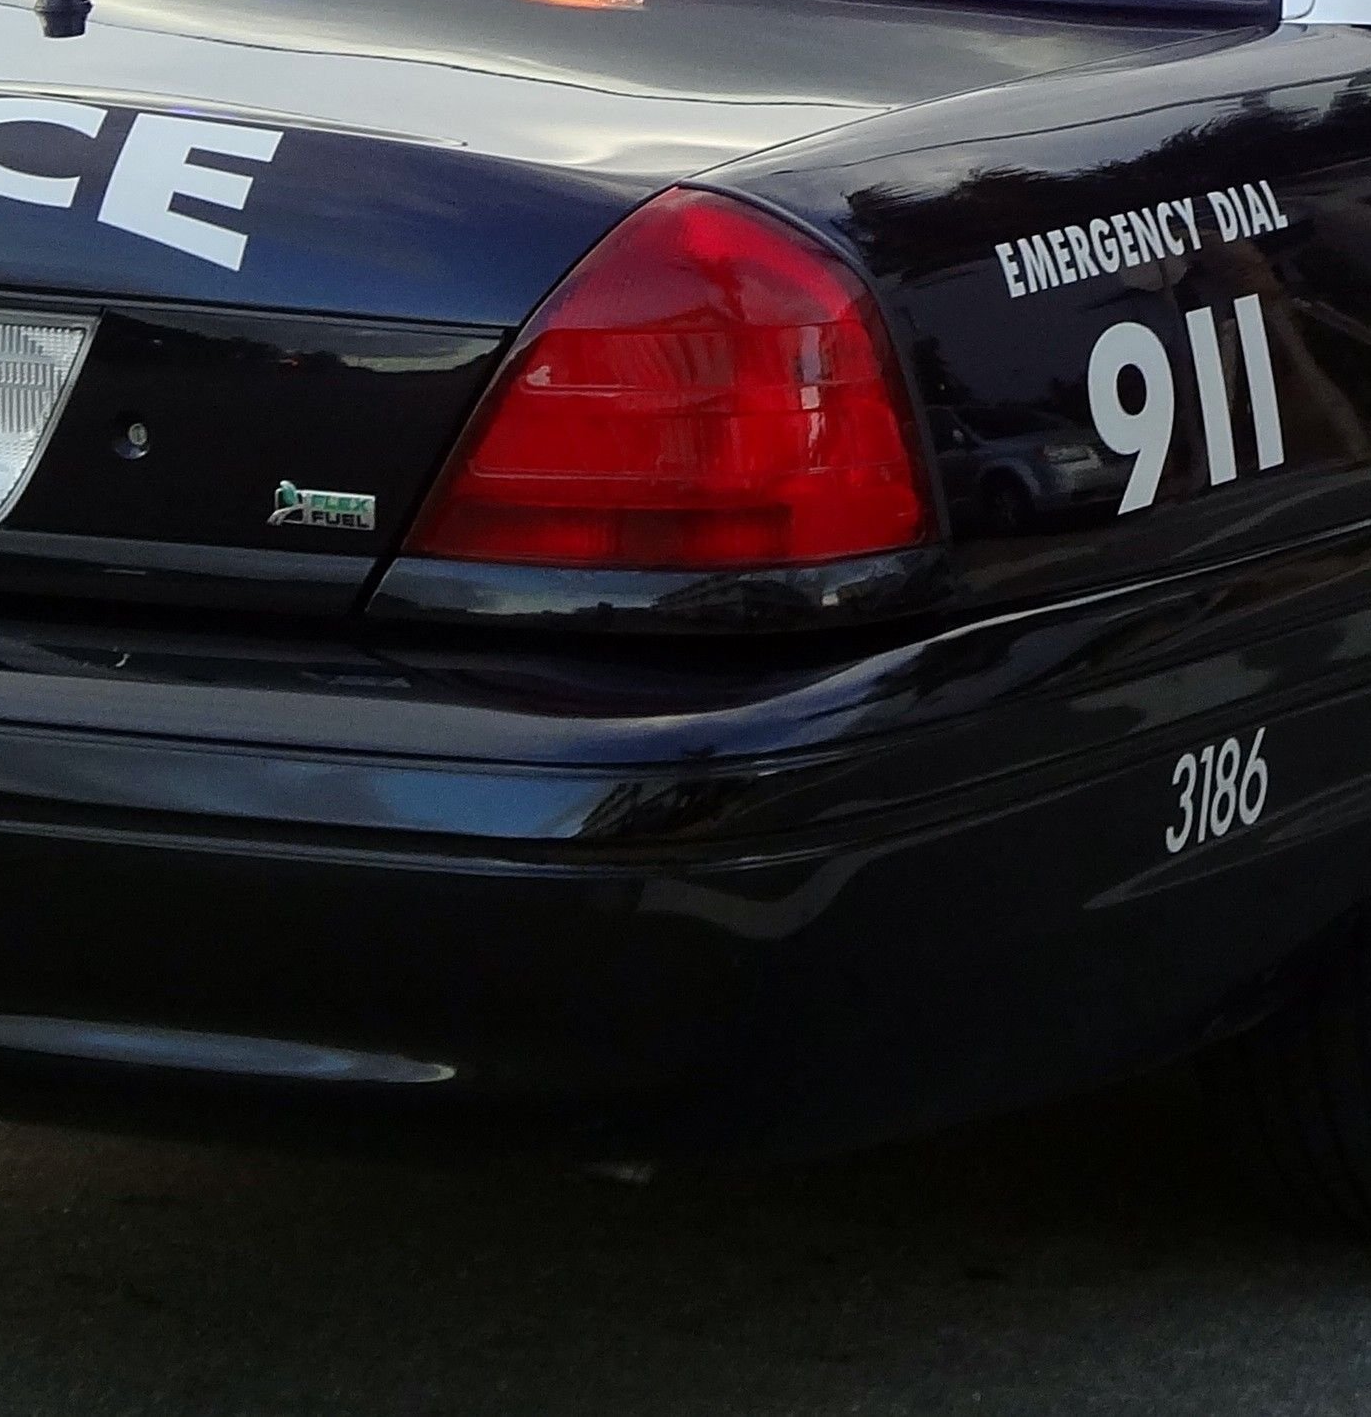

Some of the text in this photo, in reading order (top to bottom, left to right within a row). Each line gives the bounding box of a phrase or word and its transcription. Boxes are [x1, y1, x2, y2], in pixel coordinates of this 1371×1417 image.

[994, 179, 1289, 298] EMERGENCY DIAL
[1087, 293, 1285, 516] 911
[311, 510, 370, 528] FUEL
[1165, 726, 1269, 854] 3186
